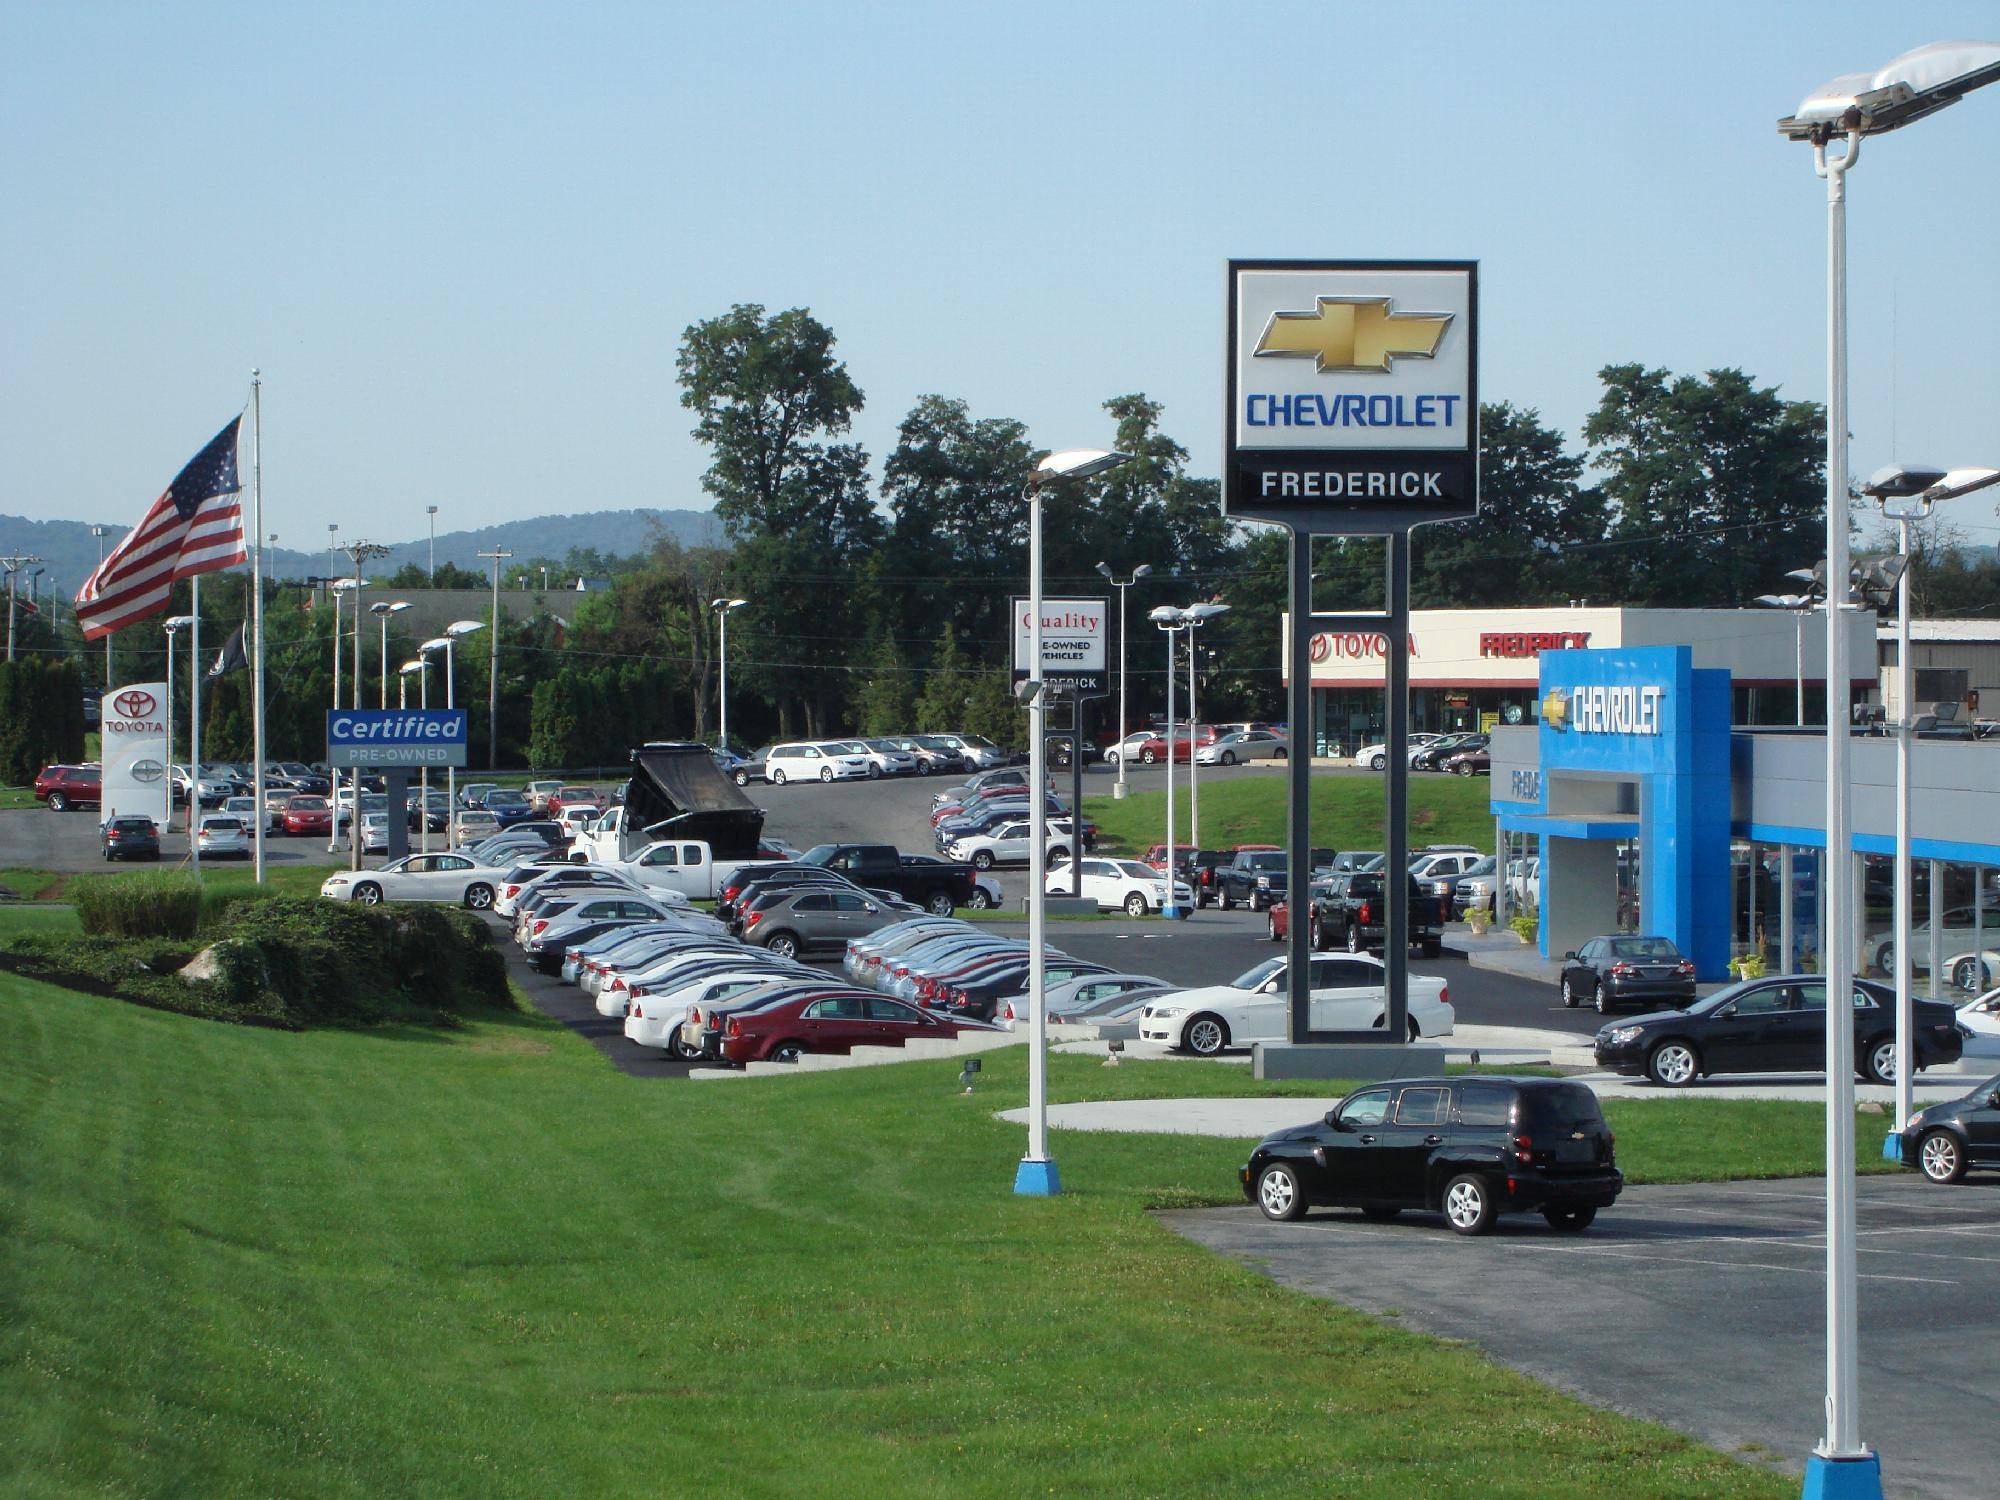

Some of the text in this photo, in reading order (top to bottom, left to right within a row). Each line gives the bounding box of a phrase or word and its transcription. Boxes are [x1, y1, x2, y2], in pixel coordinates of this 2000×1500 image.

[1246, 394, 1460, 427] CHEVROLET
[1261, 471, 1443, 497] FREDERICK
[1042, 641, 1091, 650] E-OWNED
[1331, 632, 1417, 657] TOYOA
[1479, 631, 1591, 658] FREDERICK
[1572, 685, 1660, 734] CHEVROLET
[104, 720, 164, 733] TOYOTA
[332, 716, 461, 739] Certified
[349, 748, 448, 761] PRE-OWNED
